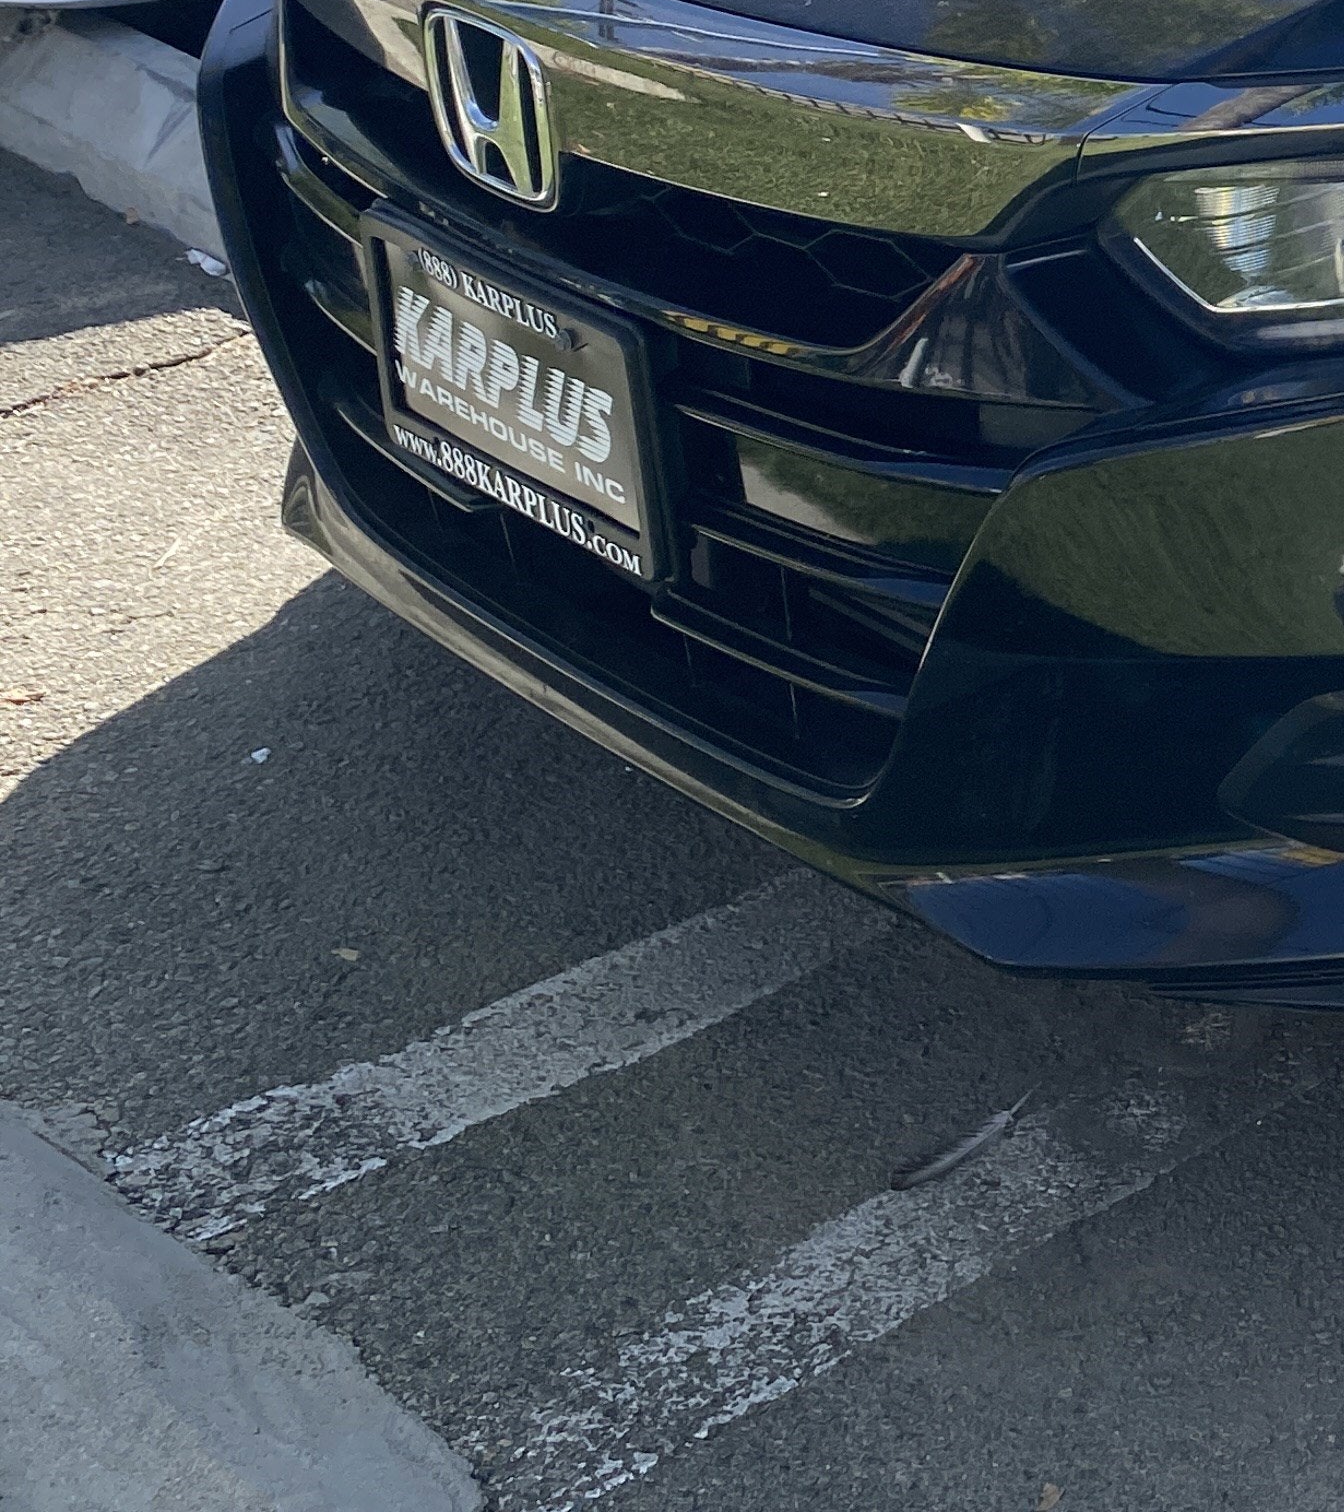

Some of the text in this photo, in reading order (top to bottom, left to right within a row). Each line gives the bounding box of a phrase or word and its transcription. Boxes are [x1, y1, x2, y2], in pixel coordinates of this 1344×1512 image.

[418, 248, 559, 338] (888) KARPLUS
[394, 285, 614, 463] KARPLUS
[395, 359, 626, 504] WAREHOUSE INC
